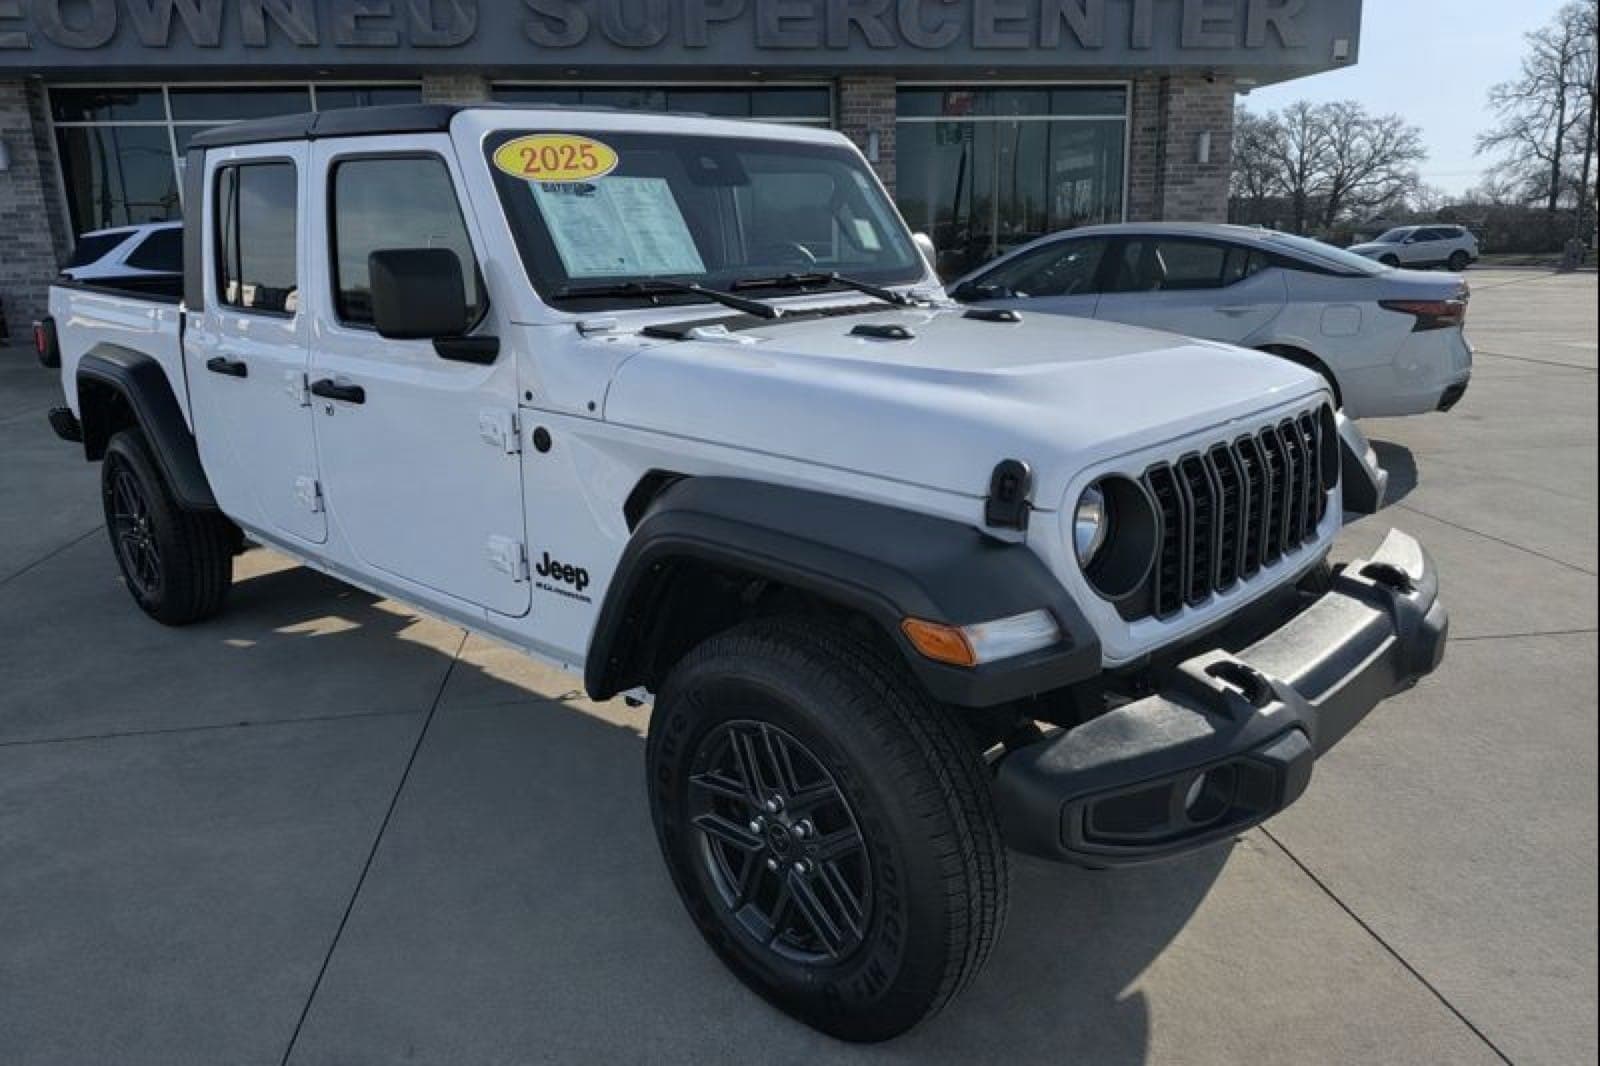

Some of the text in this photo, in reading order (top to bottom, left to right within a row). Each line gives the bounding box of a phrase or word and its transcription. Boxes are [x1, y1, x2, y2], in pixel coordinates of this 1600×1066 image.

[524, 0, 1304, 49] SUPERCENTER
[519, 143, 600, 174] 2025
[535, 551, 590, 592] Jeep
